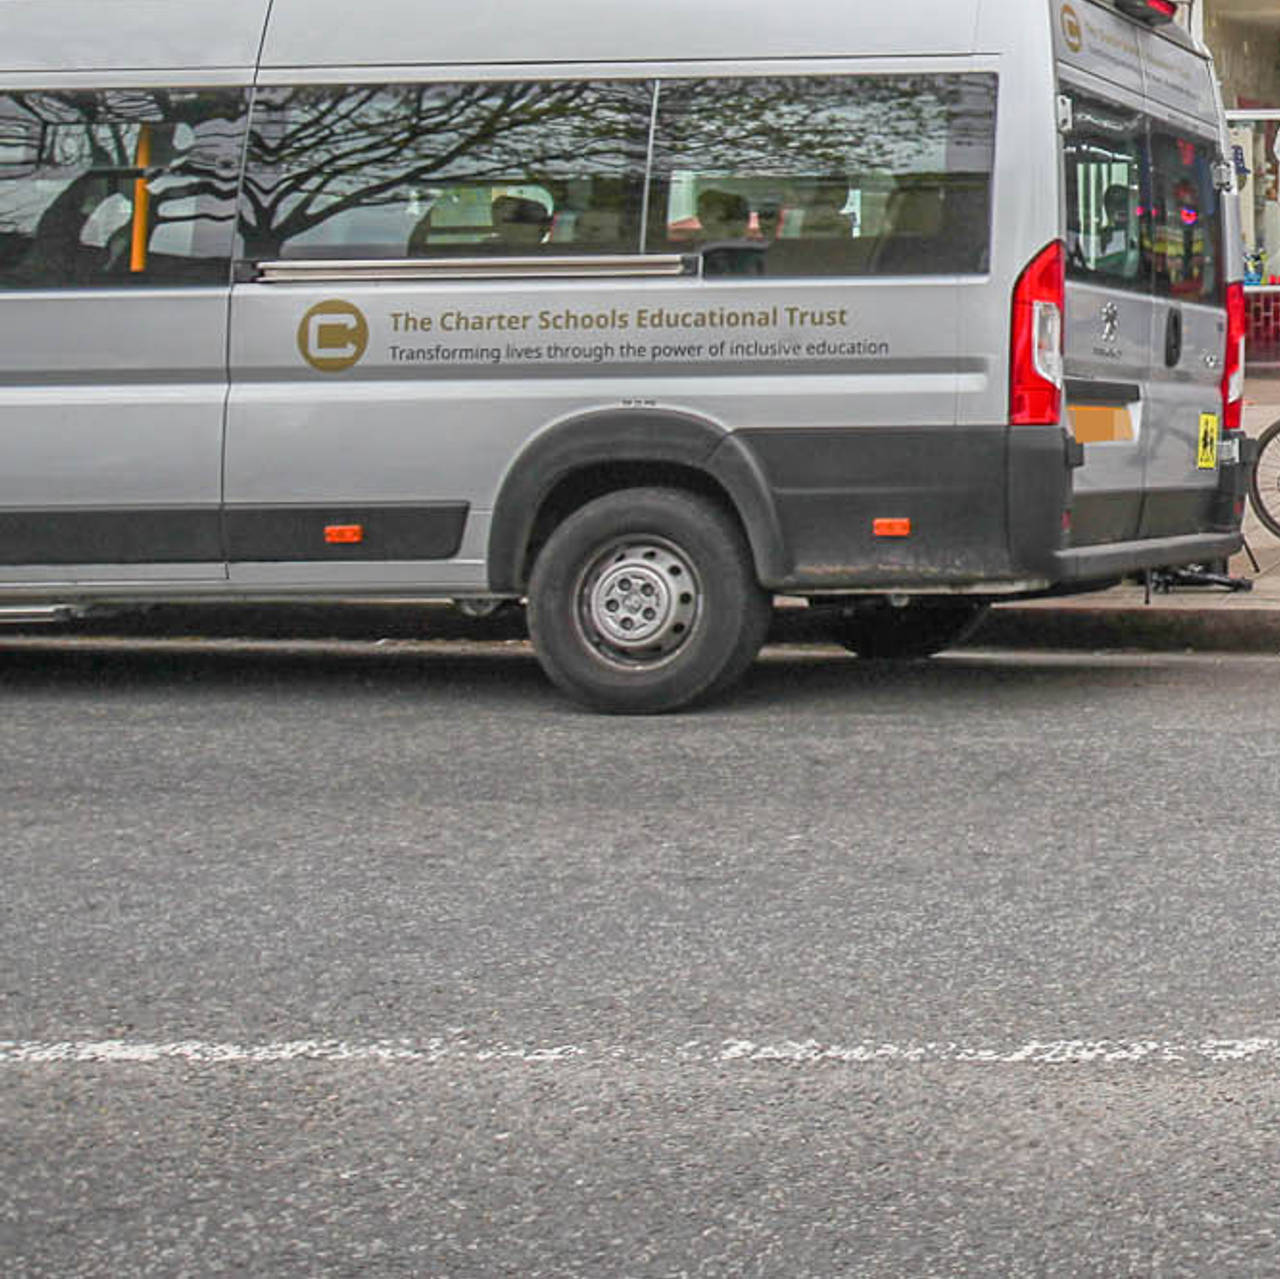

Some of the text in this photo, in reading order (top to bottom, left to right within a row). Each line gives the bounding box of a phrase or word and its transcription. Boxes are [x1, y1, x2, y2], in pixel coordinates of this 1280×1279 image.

[390, 306, 847, 332] The Charter Schools Educational Trust
[390, 339, 889, 363] Transforming lives through the power of inclusive education
